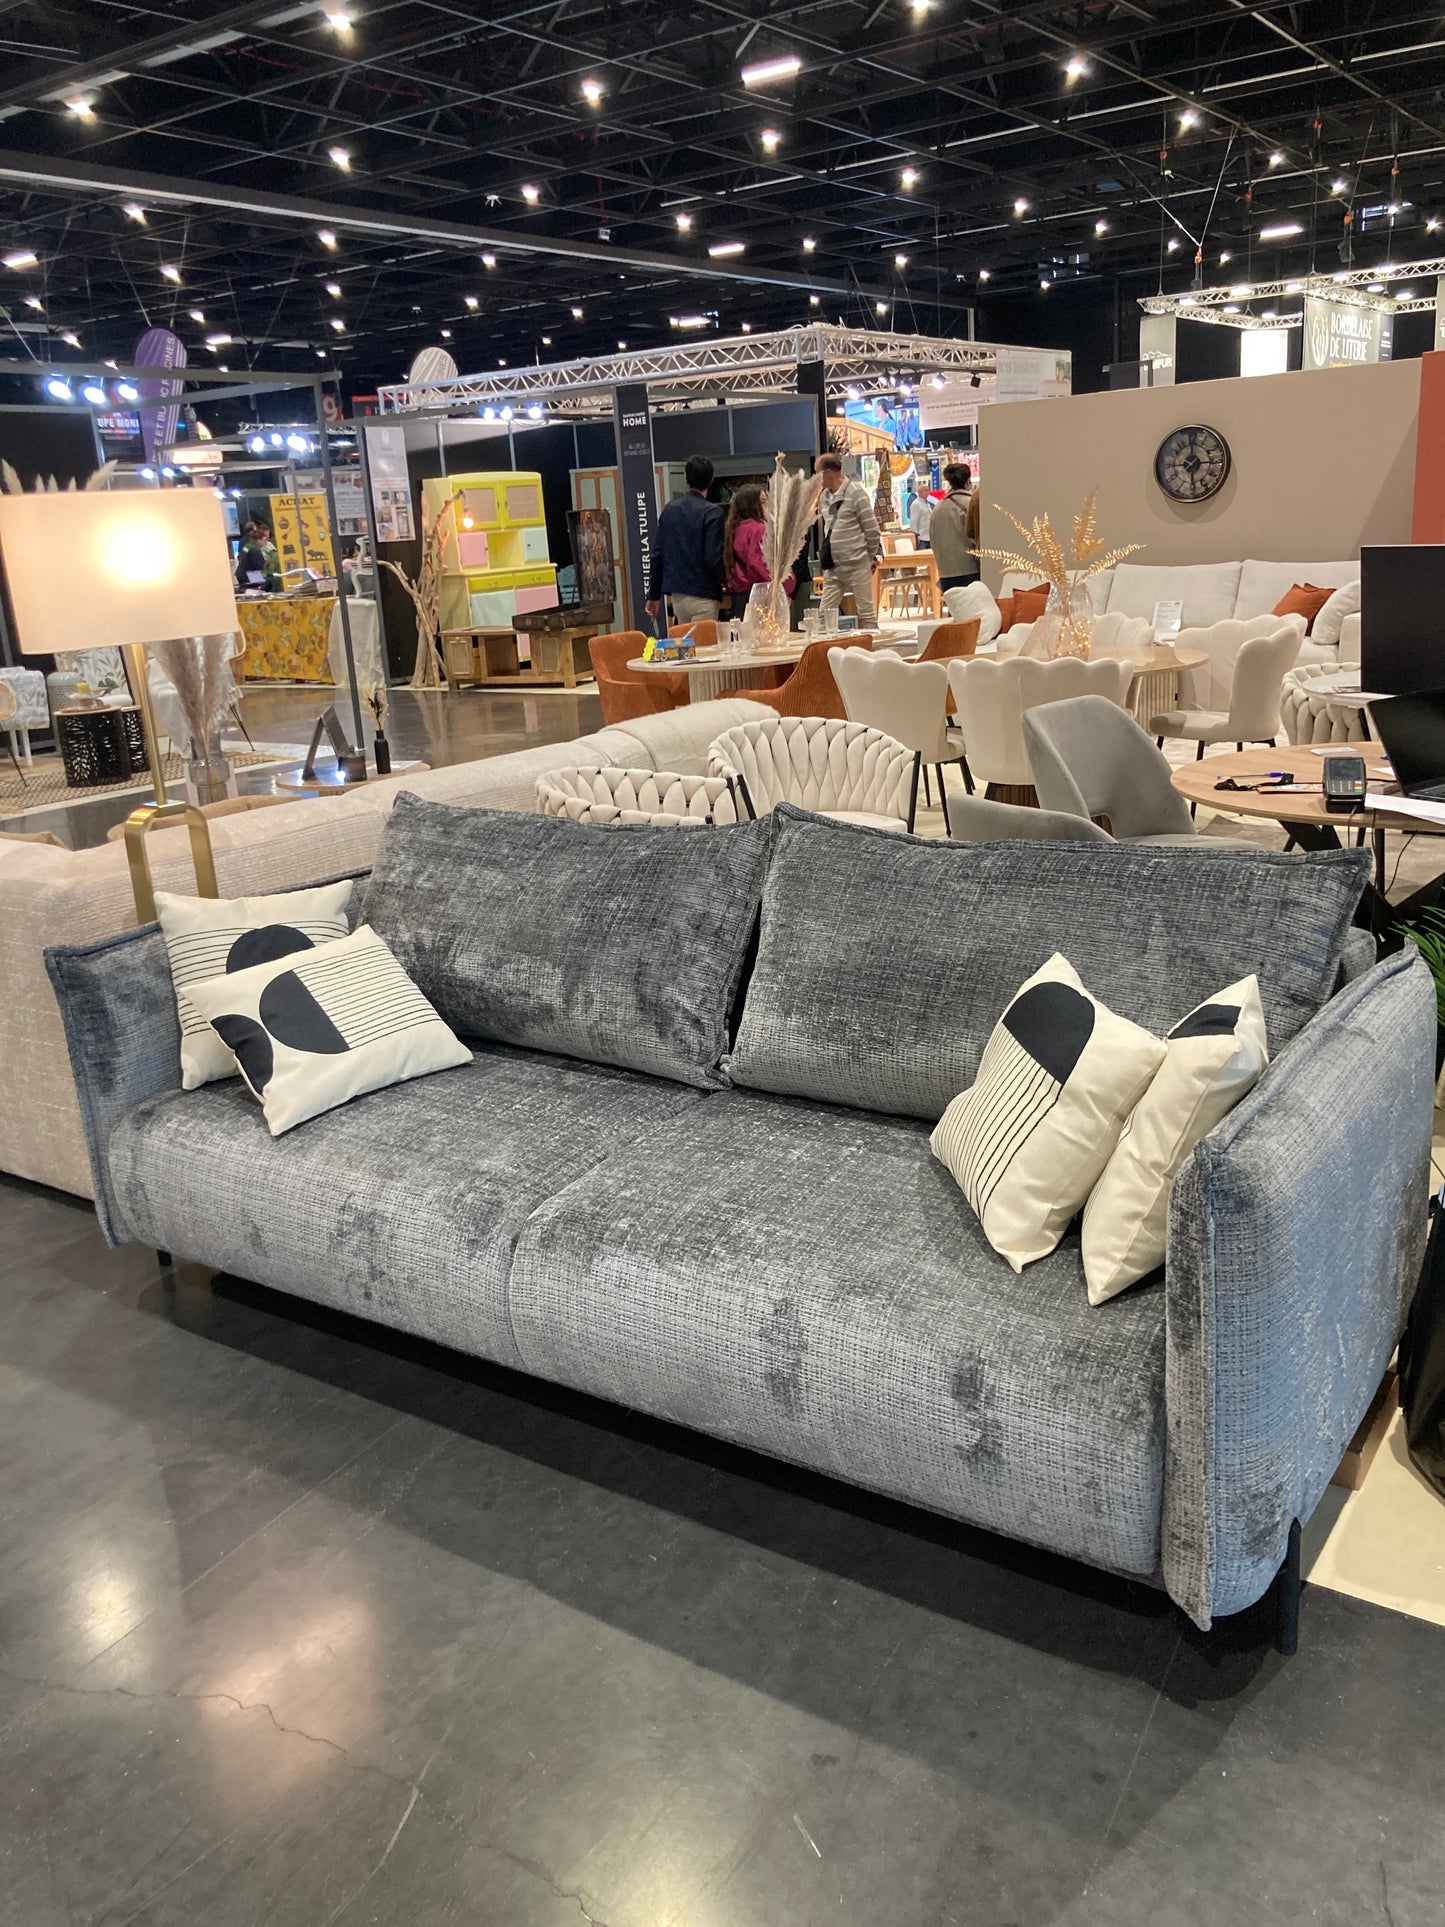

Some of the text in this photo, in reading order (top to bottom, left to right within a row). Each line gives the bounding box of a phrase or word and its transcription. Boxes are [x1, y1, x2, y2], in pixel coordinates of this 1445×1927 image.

[1331, 312, 1374, 339] BORDELAISE
[1330, 336, 1368, 361] DE LITERIE
[622, 416, 647, 427] HOME
[637, 492, 649, 535] TULIPE
[640, 536, 650, 552] LA
